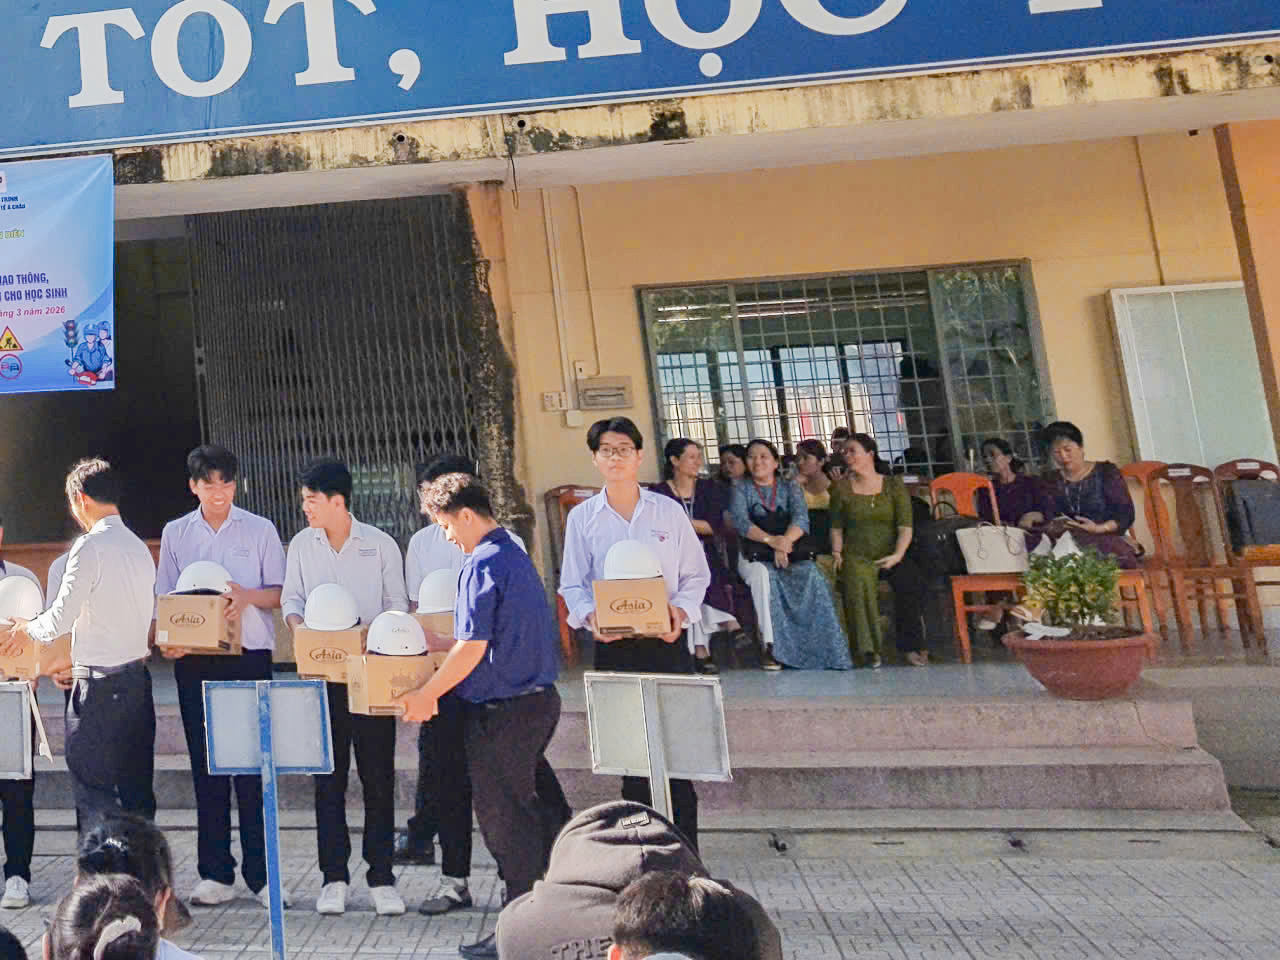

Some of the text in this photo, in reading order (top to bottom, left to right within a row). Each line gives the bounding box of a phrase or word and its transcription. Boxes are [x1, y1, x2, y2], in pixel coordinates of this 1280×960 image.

[16, 271, 49, 285] THÔNG,
[4, 290, 22, 302] CHO
[24, 289, 43, 303] HỌC
[46, 287, 68, 299] SINH
[24, 307, 43, 316] năm
[45, 305, 65, 315] 2026
[315, 648, 342, 660] Asia
